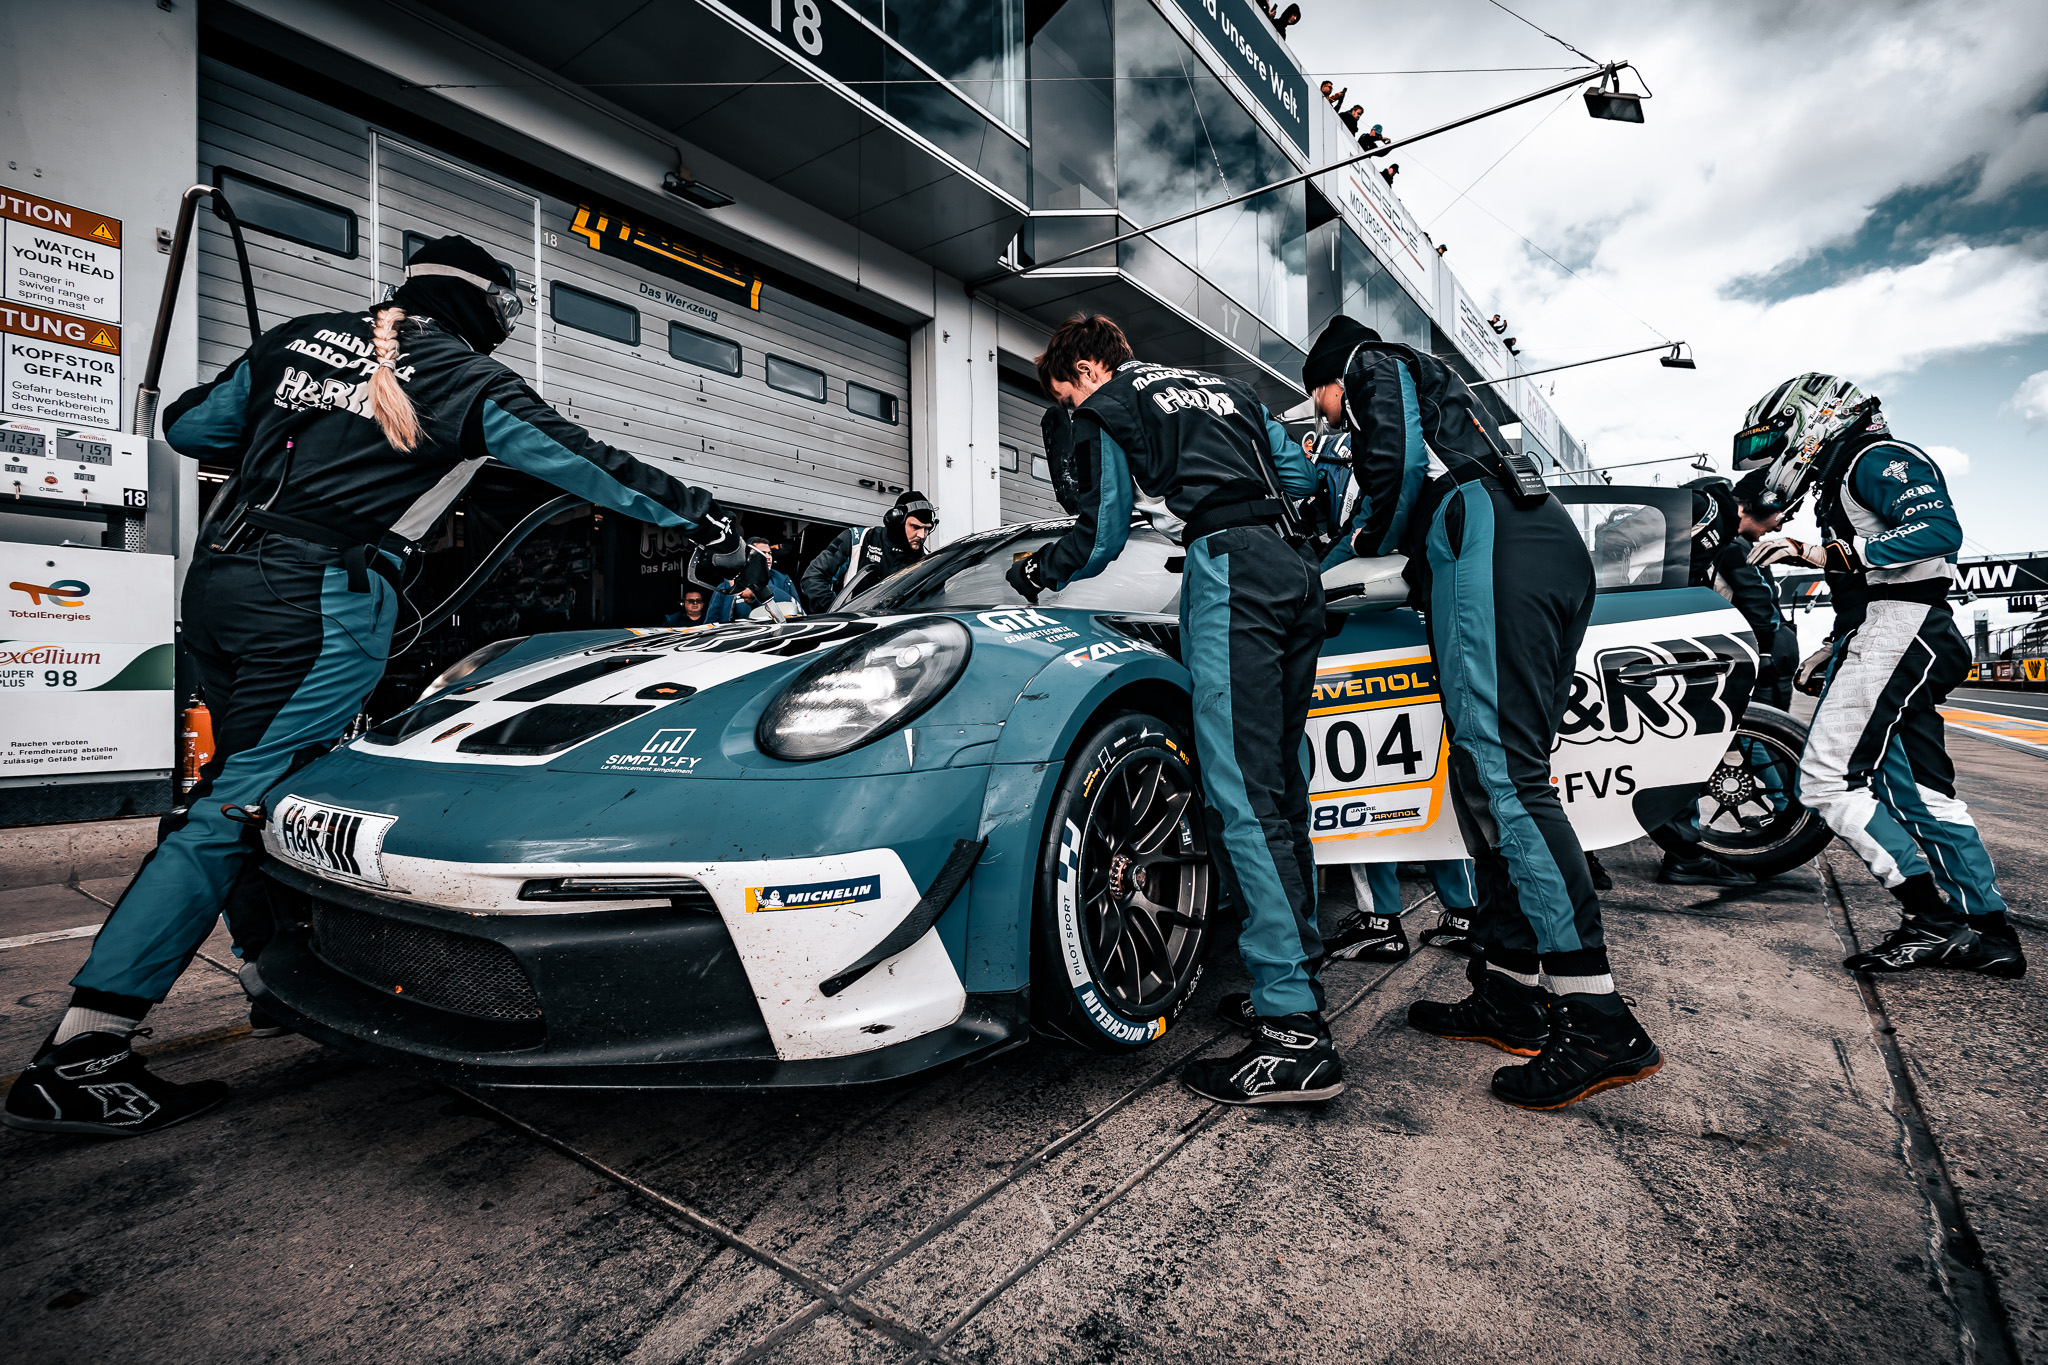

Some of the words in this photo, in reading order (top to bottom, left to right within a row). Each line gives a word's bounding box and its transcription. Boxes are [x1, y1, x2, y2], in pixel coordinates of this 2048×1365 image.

[771, 0, 823, 56] 18
[1221, 11, 1267, 81] unsere
[1269, 64, 1300, 123] Welt.
[1350, 190, 1391, 251] MOTORSPORT
[34, 237, 95, 262] WATCH
[544, 232, 557, 247] 18
[12, 245, 62, 268] YOUR
[68, 260, 114, 280] HEAD
[19, 268, 62, 284] Danger
[65, 279, 75, 288] in
[19, 279, 54, 293] swivel
[58, 287, 90, 301] range
[93, 297, 104, 305] of
[19, 290, 54, 305] spring
[58, 299, 85, 310] mast
[639, 283, 661, 299] Das
[666, 292, 718, 321] Werkzeug
[1221, 302, 1240, 339] 17
[12, 344, 115, 374] KOPFSTOß
[24, 363, 103, 387] GEFAHR
[12, 380, 53, 395] Gefahr
[56, 388, 97, 403] besteht
[100, 396, 114, 405] im
[12, 391, 106, 414] Schwenkbereich
[273, 398, 288, 409] Das
[11, 403, 33, 412] des
[37, 406, 110, 425] Federmastes
[1527, 389, 1547, 434] ROWE
[123, 489, 146, 507] 18
[641, 564, 659, 575] Das
[661, 561, 680, 573] Fah
[1949, 564, 2018, 591] MW
[9, 610, 91, 621] TotalEnergies
[1004, 625, 1072, 644] GEBÄUDETECHNIK
[1045, 631, 1080, 643] KIRCHEN
[0, 648, 101, 665] excellium
[1064, 640, 1142, 668] FALK
[44, 670, 77, 687] 98
[1311, 672, 1429, 700] AVENOL
[3, 757, 44, 765] zulässige
[47, 755, 77, 763] Gefäße
[19, 747, 78, 756] Fremdheizung
[1306, 713, 1423, 783] 04
[605, 754, 702, 768] SIMPLY-FY
[1314, 802, 1367, 831] 80
[1350, 805, 1376, 813] JAHRE
[1374, 811, 1416, 820] RAVENOL
[787, 884, 872, 904] MICHELIN
[1064, 895, 1074, 939] SPORT
[1068, 943, 1082, 976] PILOT
[1081, 990, 1146, 1041] MICHELIN
